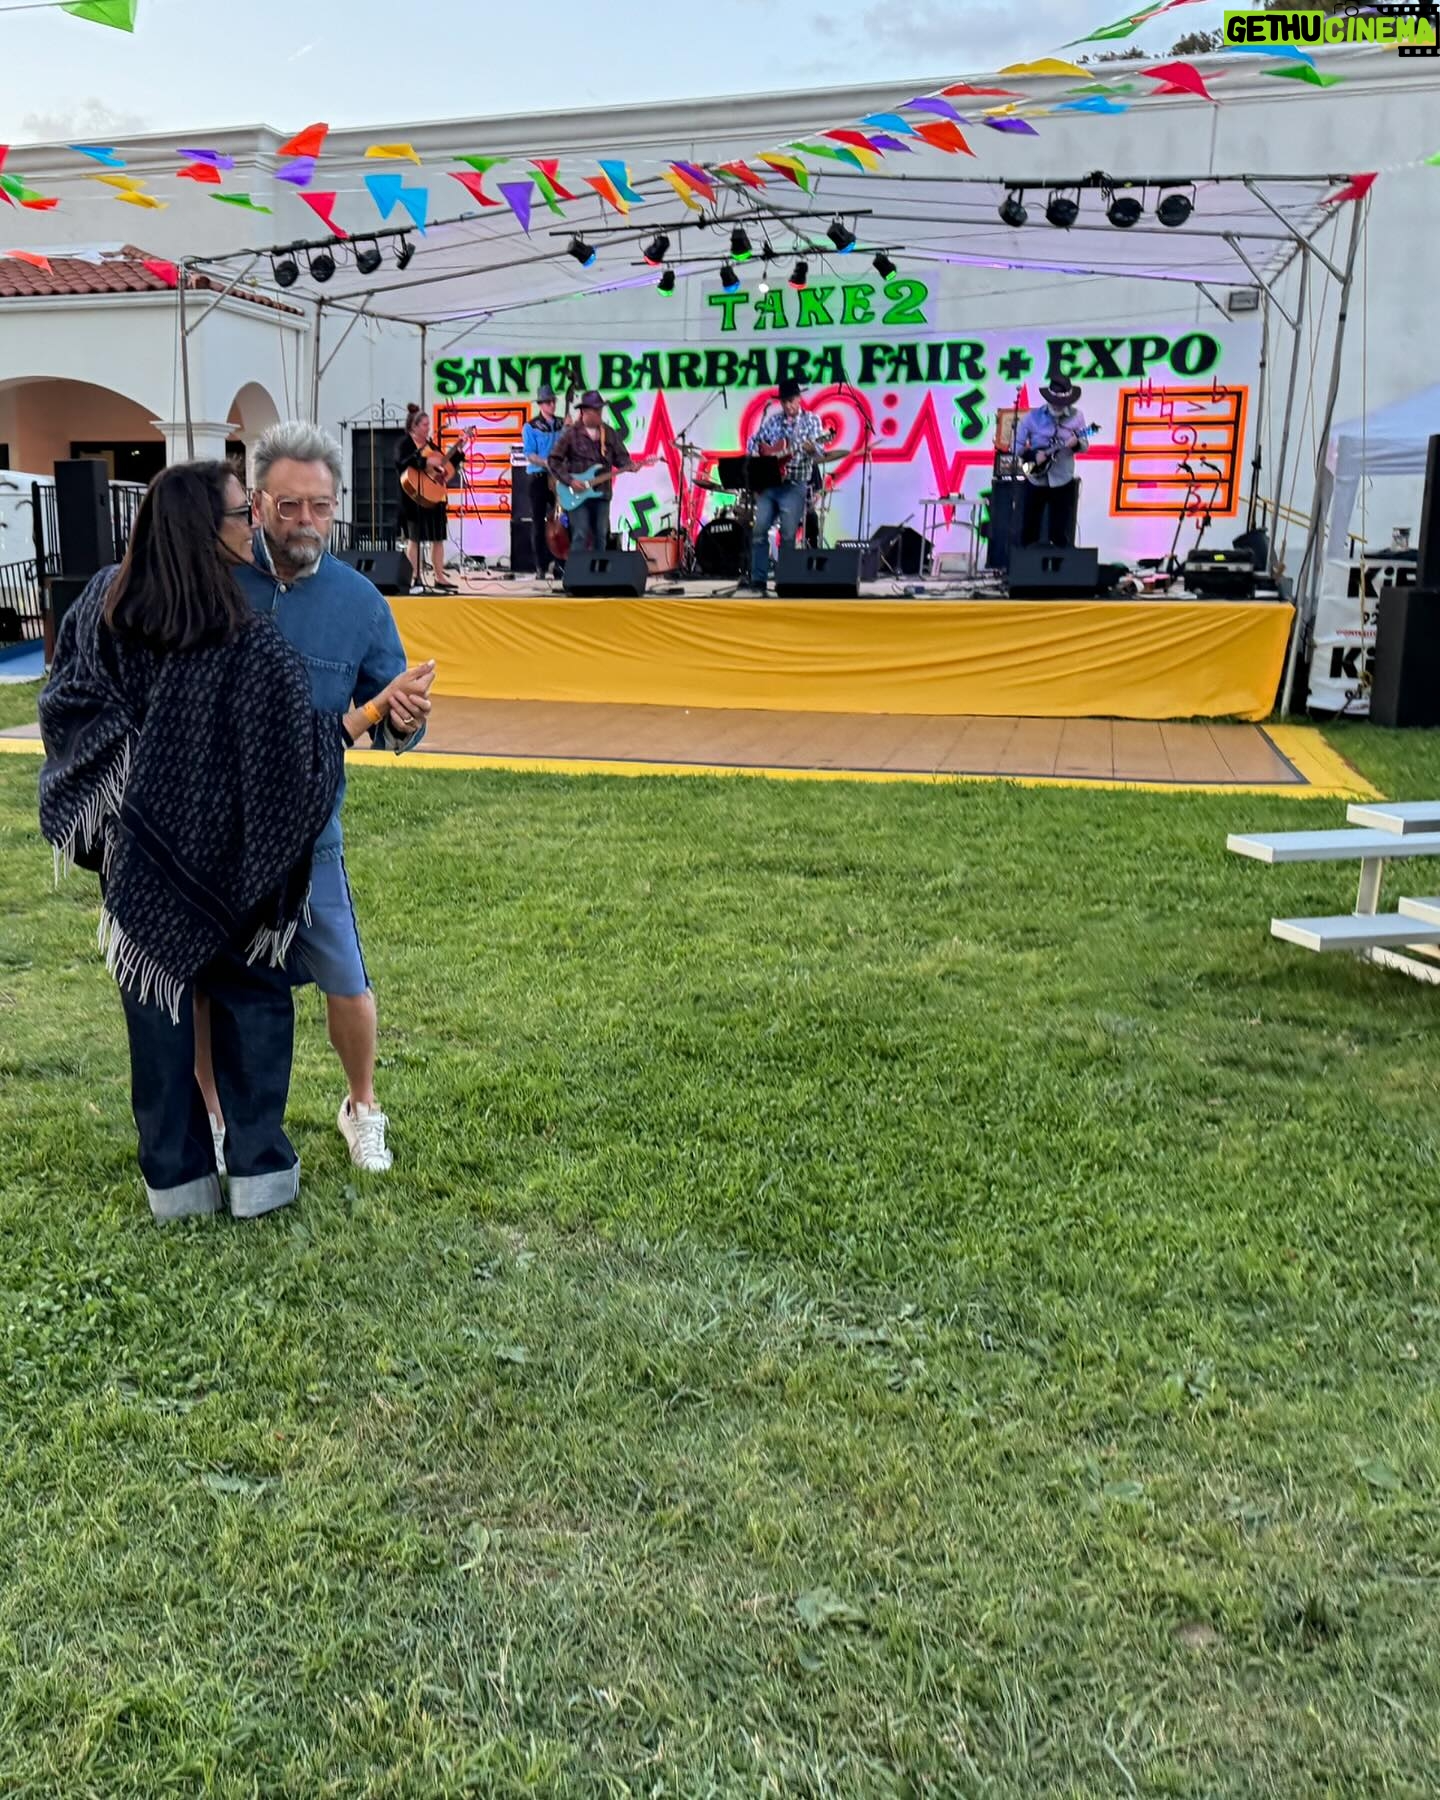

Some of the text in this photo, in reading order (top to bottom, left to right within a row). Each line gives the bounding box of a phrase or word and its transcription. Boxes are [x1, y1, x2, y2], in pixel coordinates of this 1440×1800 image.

[436, 354, 587, 395] SANTA
[600, 343, 843, 390] BARBARA
[857, 340, 987, 384] FAIR
[1045, 333, 1218, 380] EXPO
